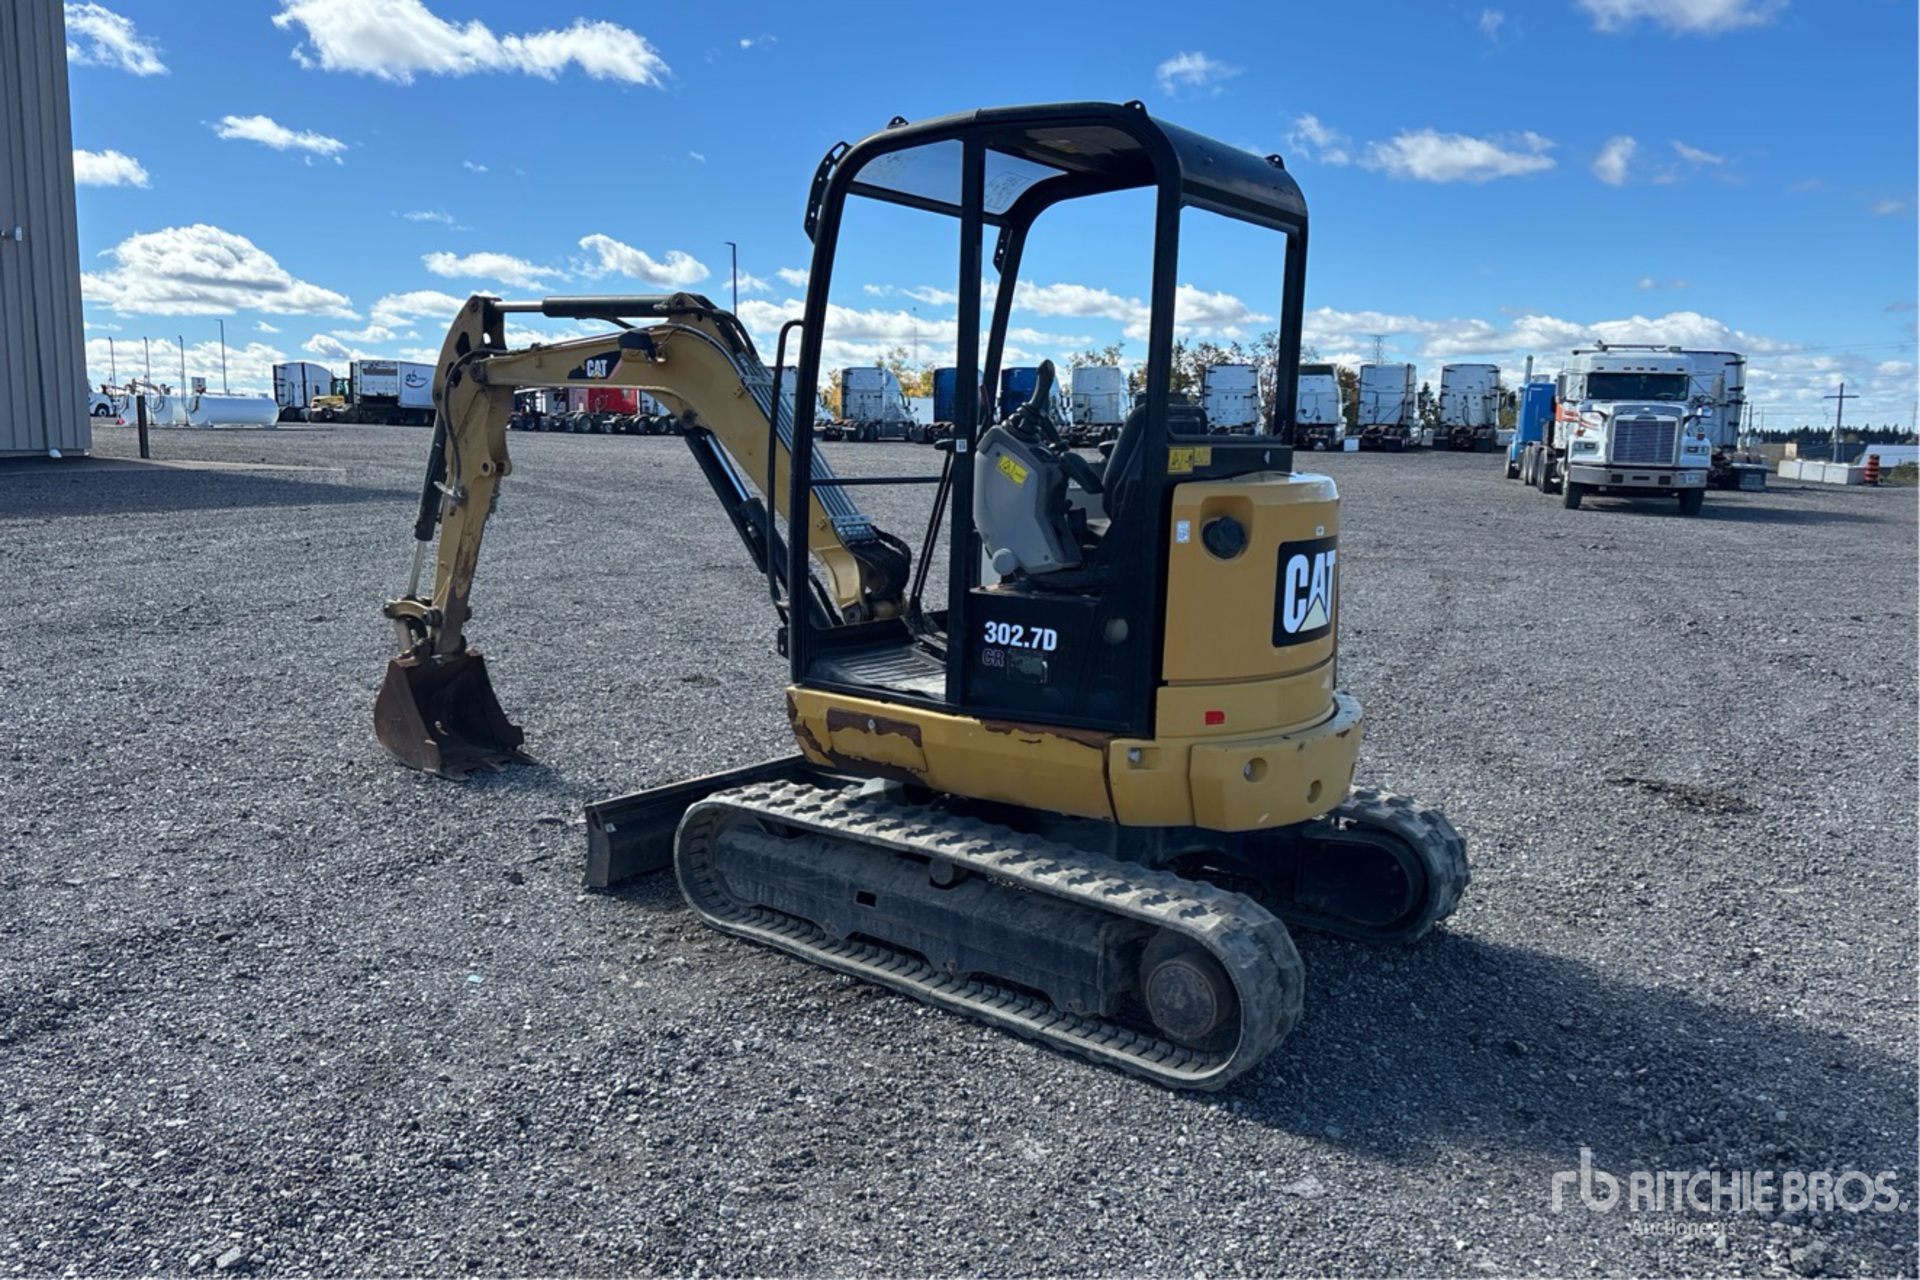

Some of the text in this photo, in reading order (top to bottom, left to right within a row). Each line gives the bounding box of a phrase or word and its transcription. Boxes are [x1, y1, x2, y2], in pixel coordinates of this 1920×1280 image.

[587, 359, 608, 378] CAT
[1283, 550, 1337, 634] CAT
[984, 621, 1058, 651] 302.7D
[982, 648, 1005, 668] CR
